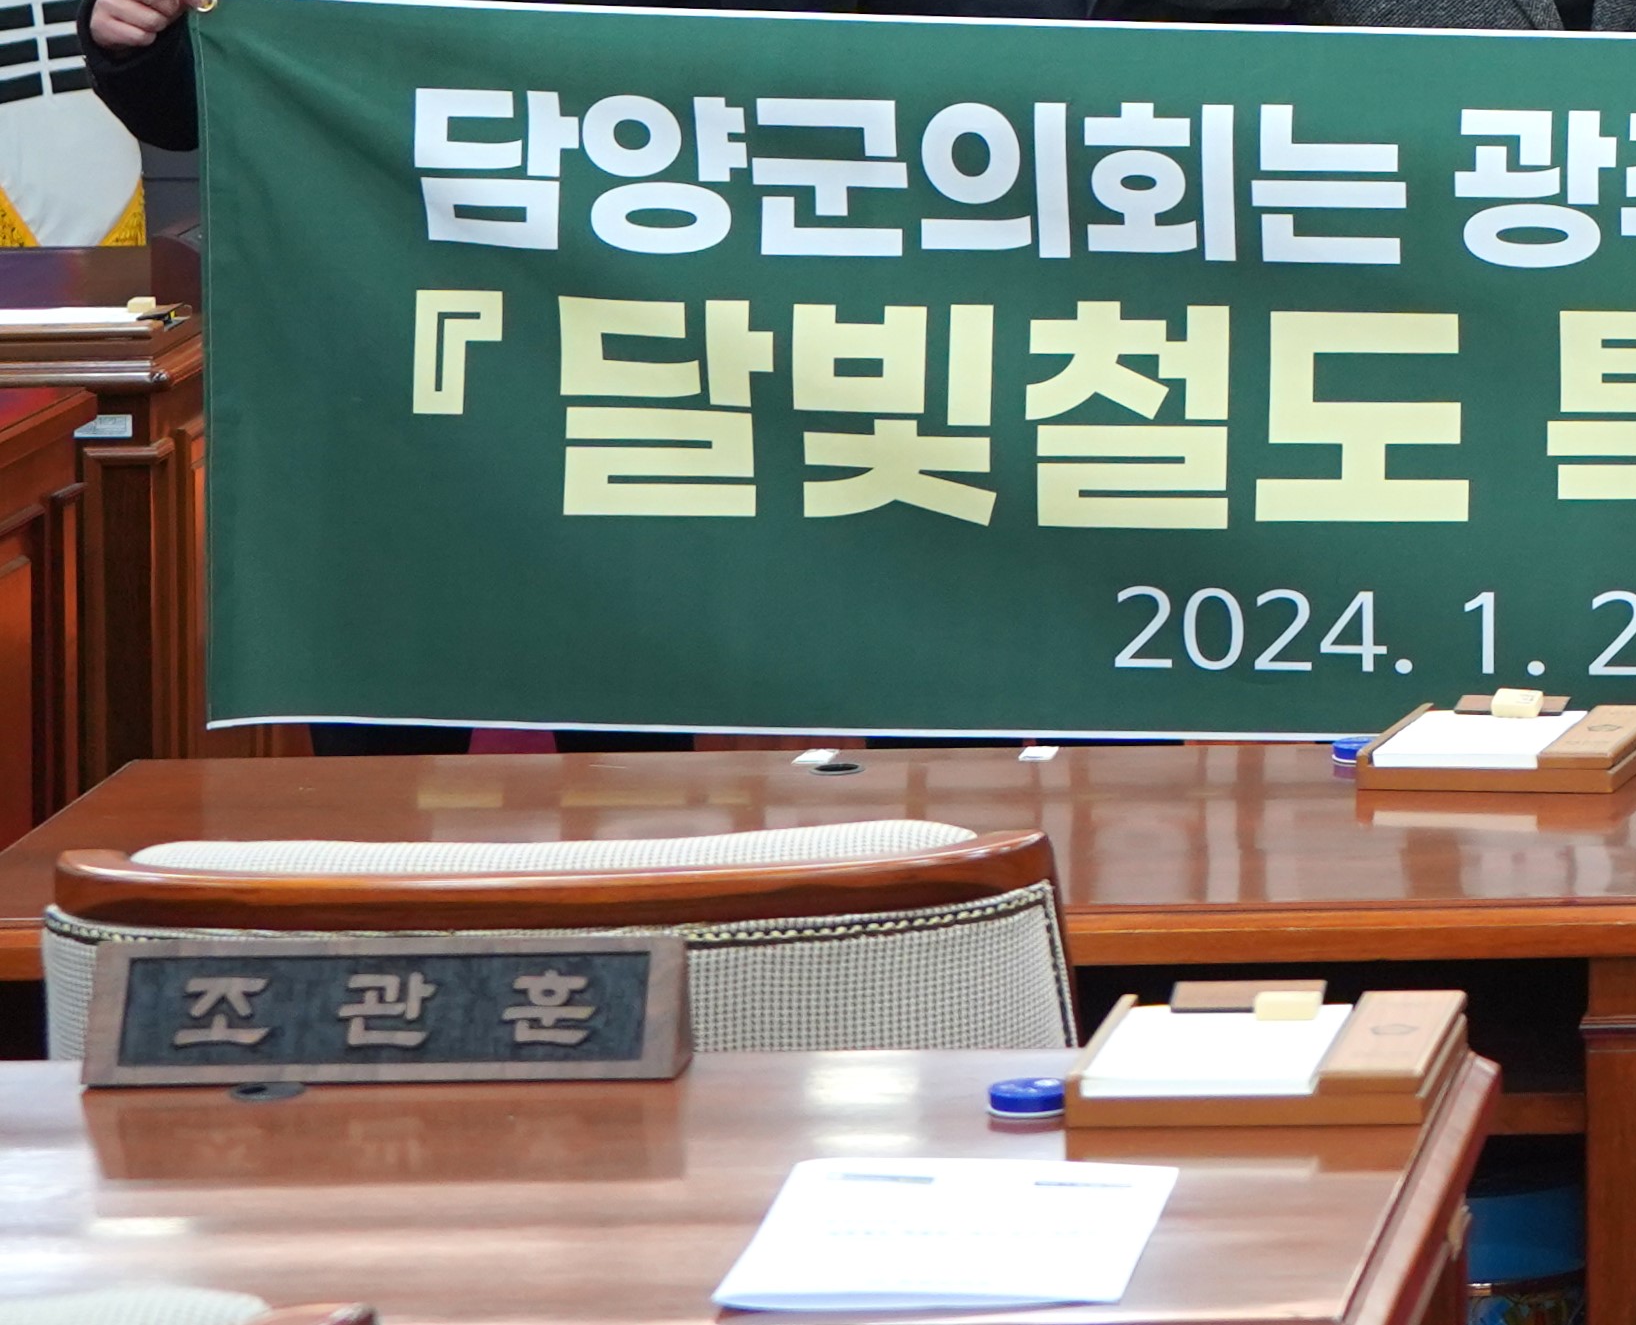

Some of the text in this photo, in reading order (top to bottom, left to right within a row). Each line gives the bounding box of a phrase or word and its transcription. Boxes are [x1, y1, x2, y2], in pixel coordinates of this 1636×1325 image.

[415, 88, 1406, 264] 담양군의회는
[1115, 586, 1412, 673] 2024.
[1465, 592, 1545, 675] 1.
